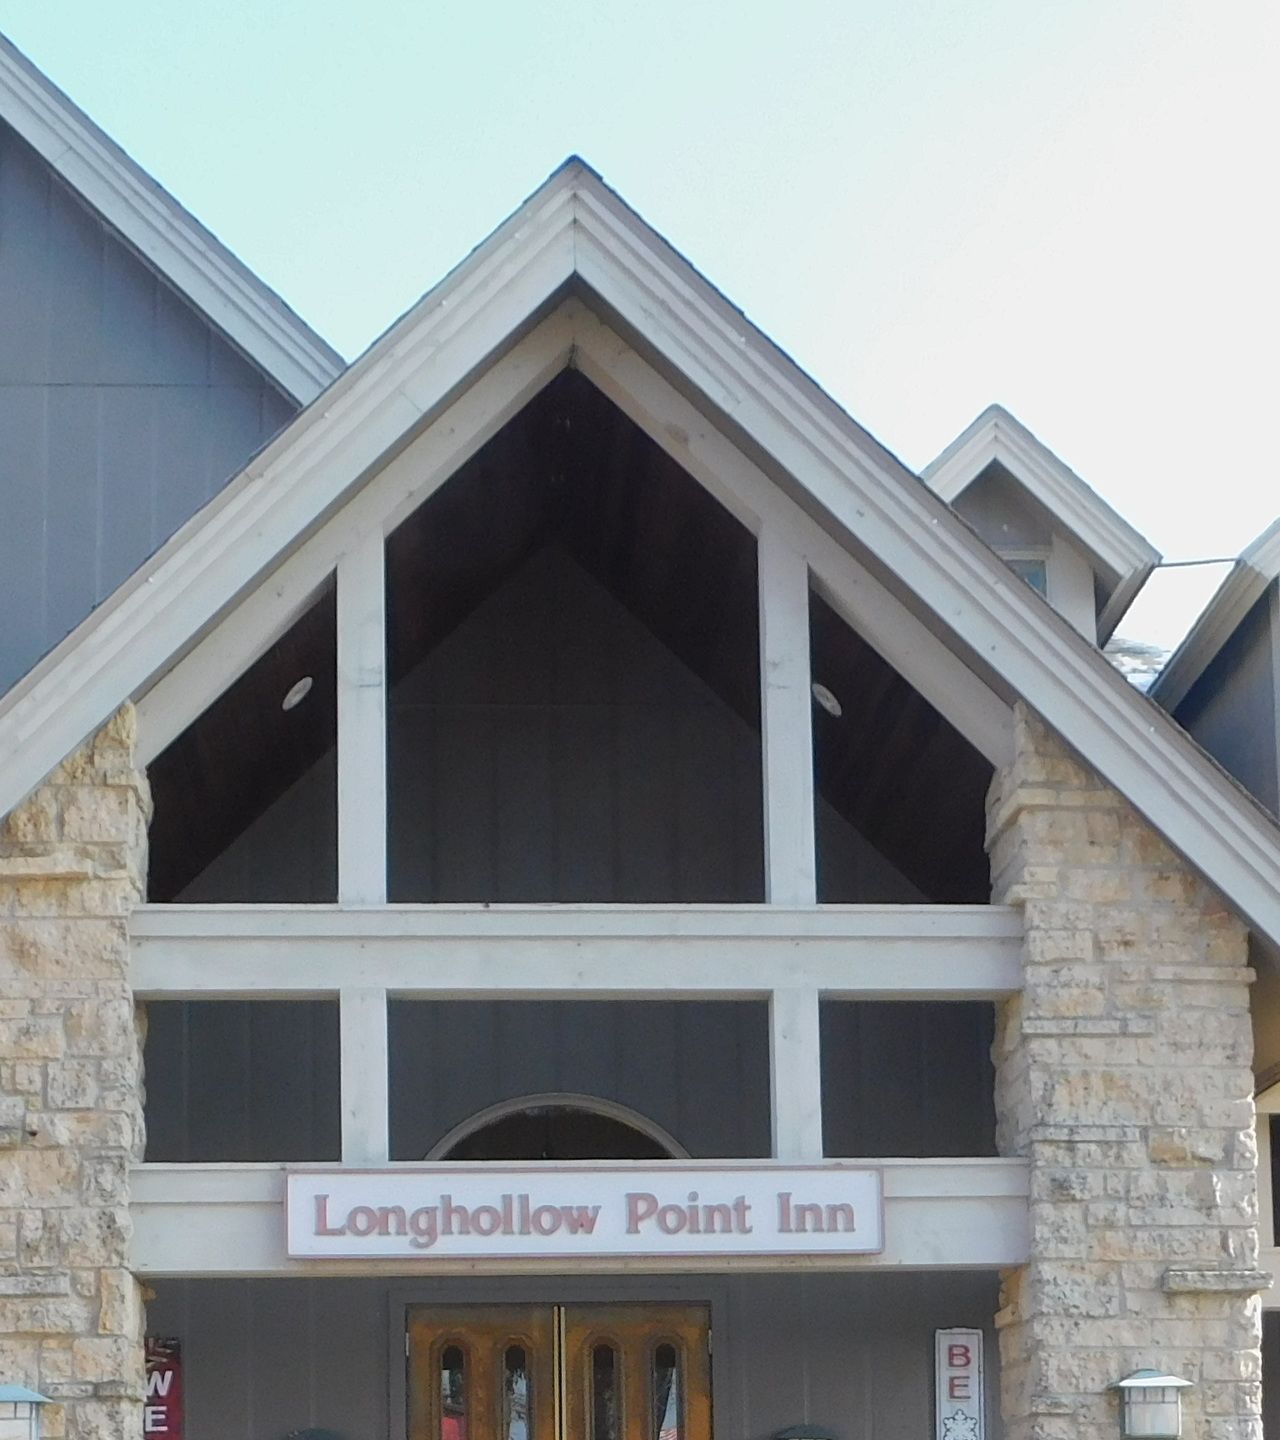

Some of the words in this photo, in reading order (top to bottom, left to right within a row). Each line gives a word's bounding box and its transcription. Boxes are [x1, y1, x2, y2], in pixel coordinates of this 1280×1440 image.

[313, 1193, 601, 1249] Longhollow
[624, 1191, 753, 1235] Point
[777, 1191, 856, 1234] Inn
[947, 1343, 972, 1400] BE
